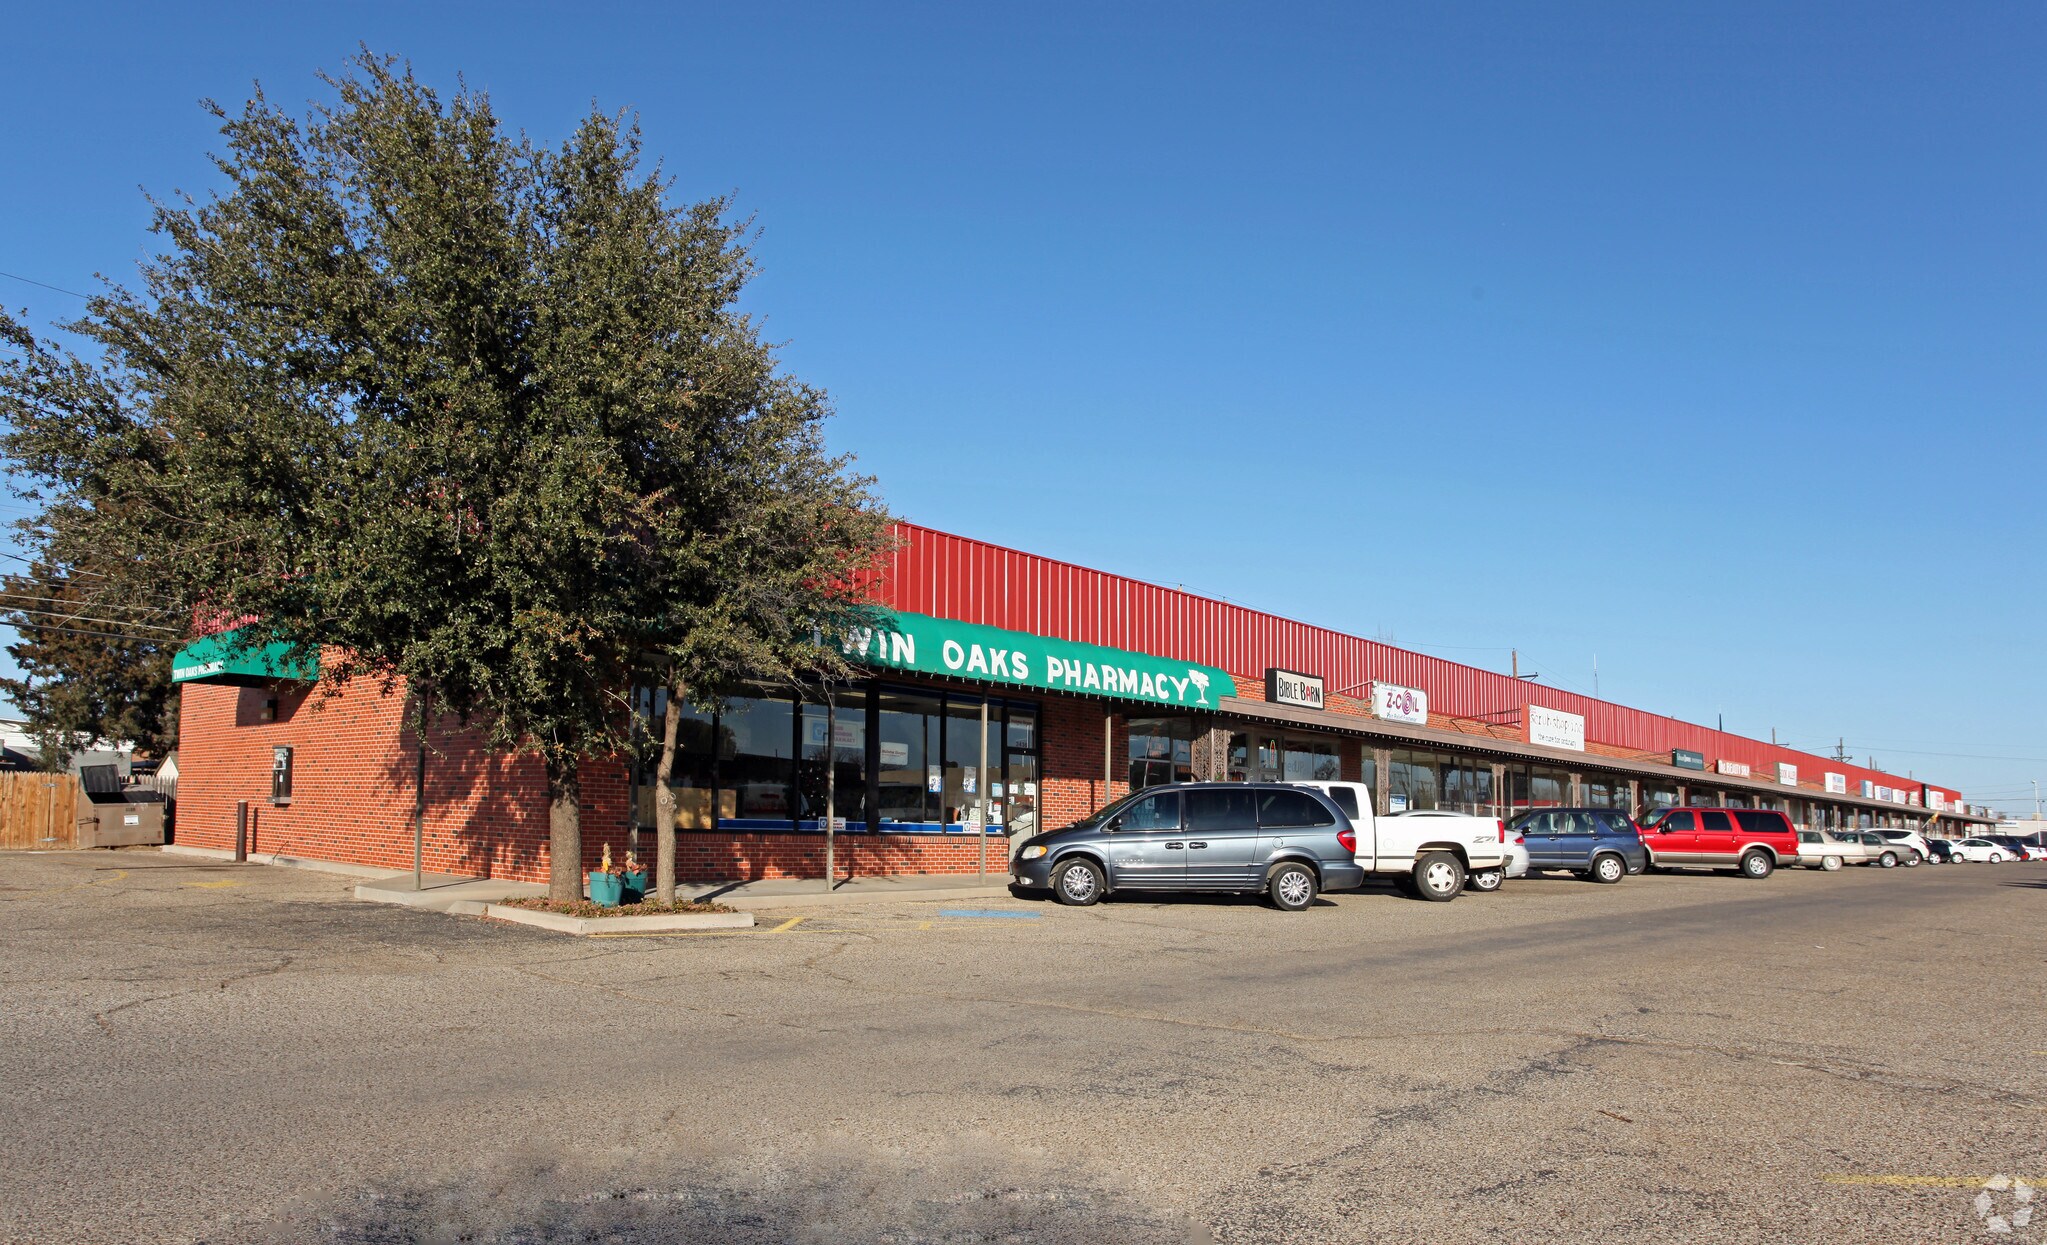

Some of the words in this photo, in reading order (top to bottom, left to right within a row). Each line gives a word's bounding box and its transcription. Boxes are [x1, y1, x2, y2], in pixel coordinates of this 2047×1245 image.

[186, 666, 197, 677] OAKS
[942, 639, 1029, 680] OAKS
[1046, 655, 1190, 701] PHARMACY
